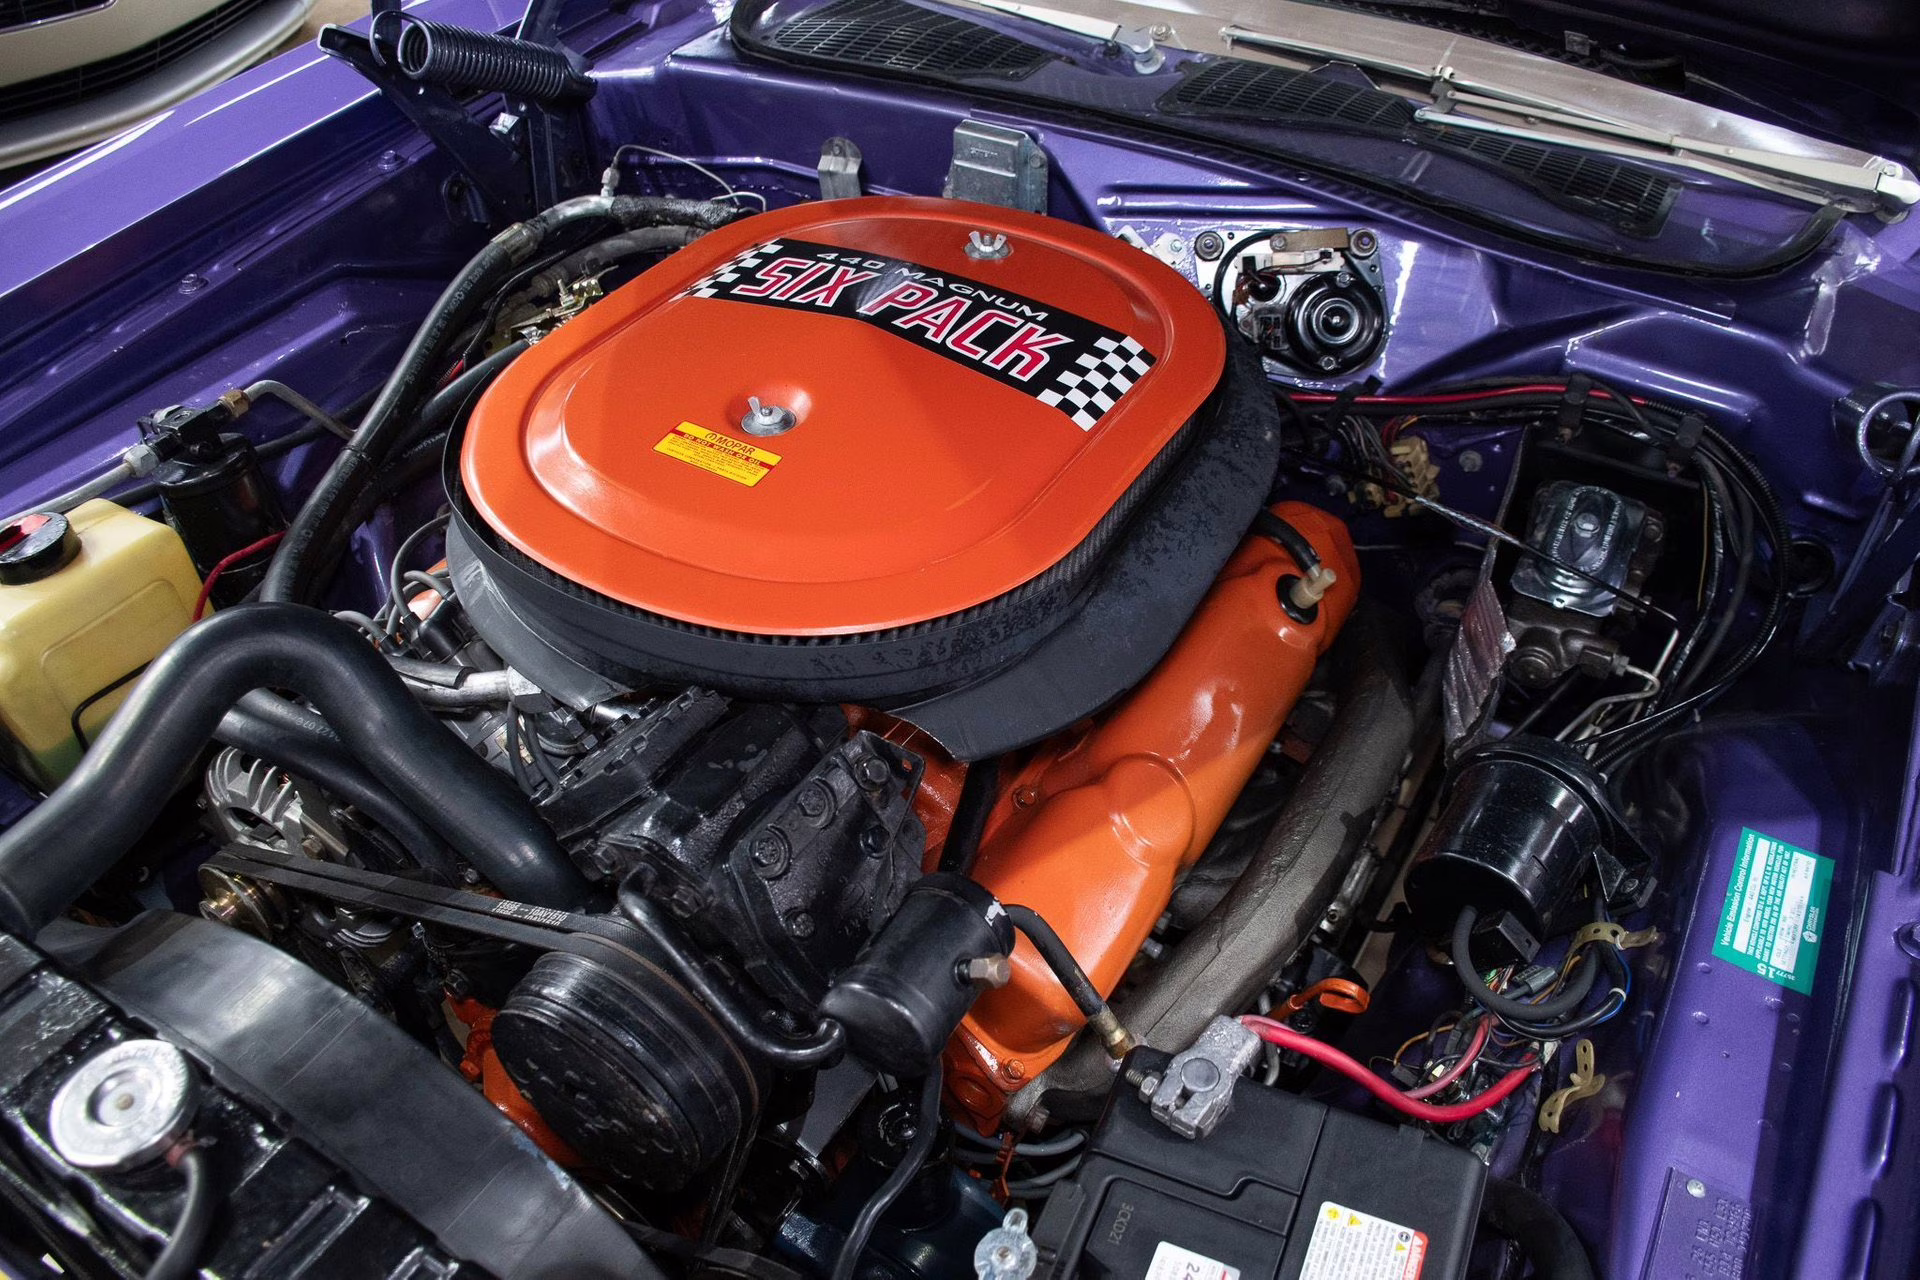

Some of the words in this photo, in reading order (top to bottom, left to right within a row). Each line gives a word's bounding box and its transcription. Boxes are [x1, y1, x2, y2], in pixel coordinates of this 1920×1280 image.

[817, 253, 885, 269] 440
[895, 267, 1049, 321] MAGNUM
[730, 257, 882, 307] SIX
[856, 280, 1075, 382] PACK
[715, 436, 756, 456] MOPAR
[1739, 834, 1755, 868] Information
[1734, 867, 1746, 891] Control
[1727, 892, 1741, 921] Emission
[1720, 922, 1733, 945] Vehicle
